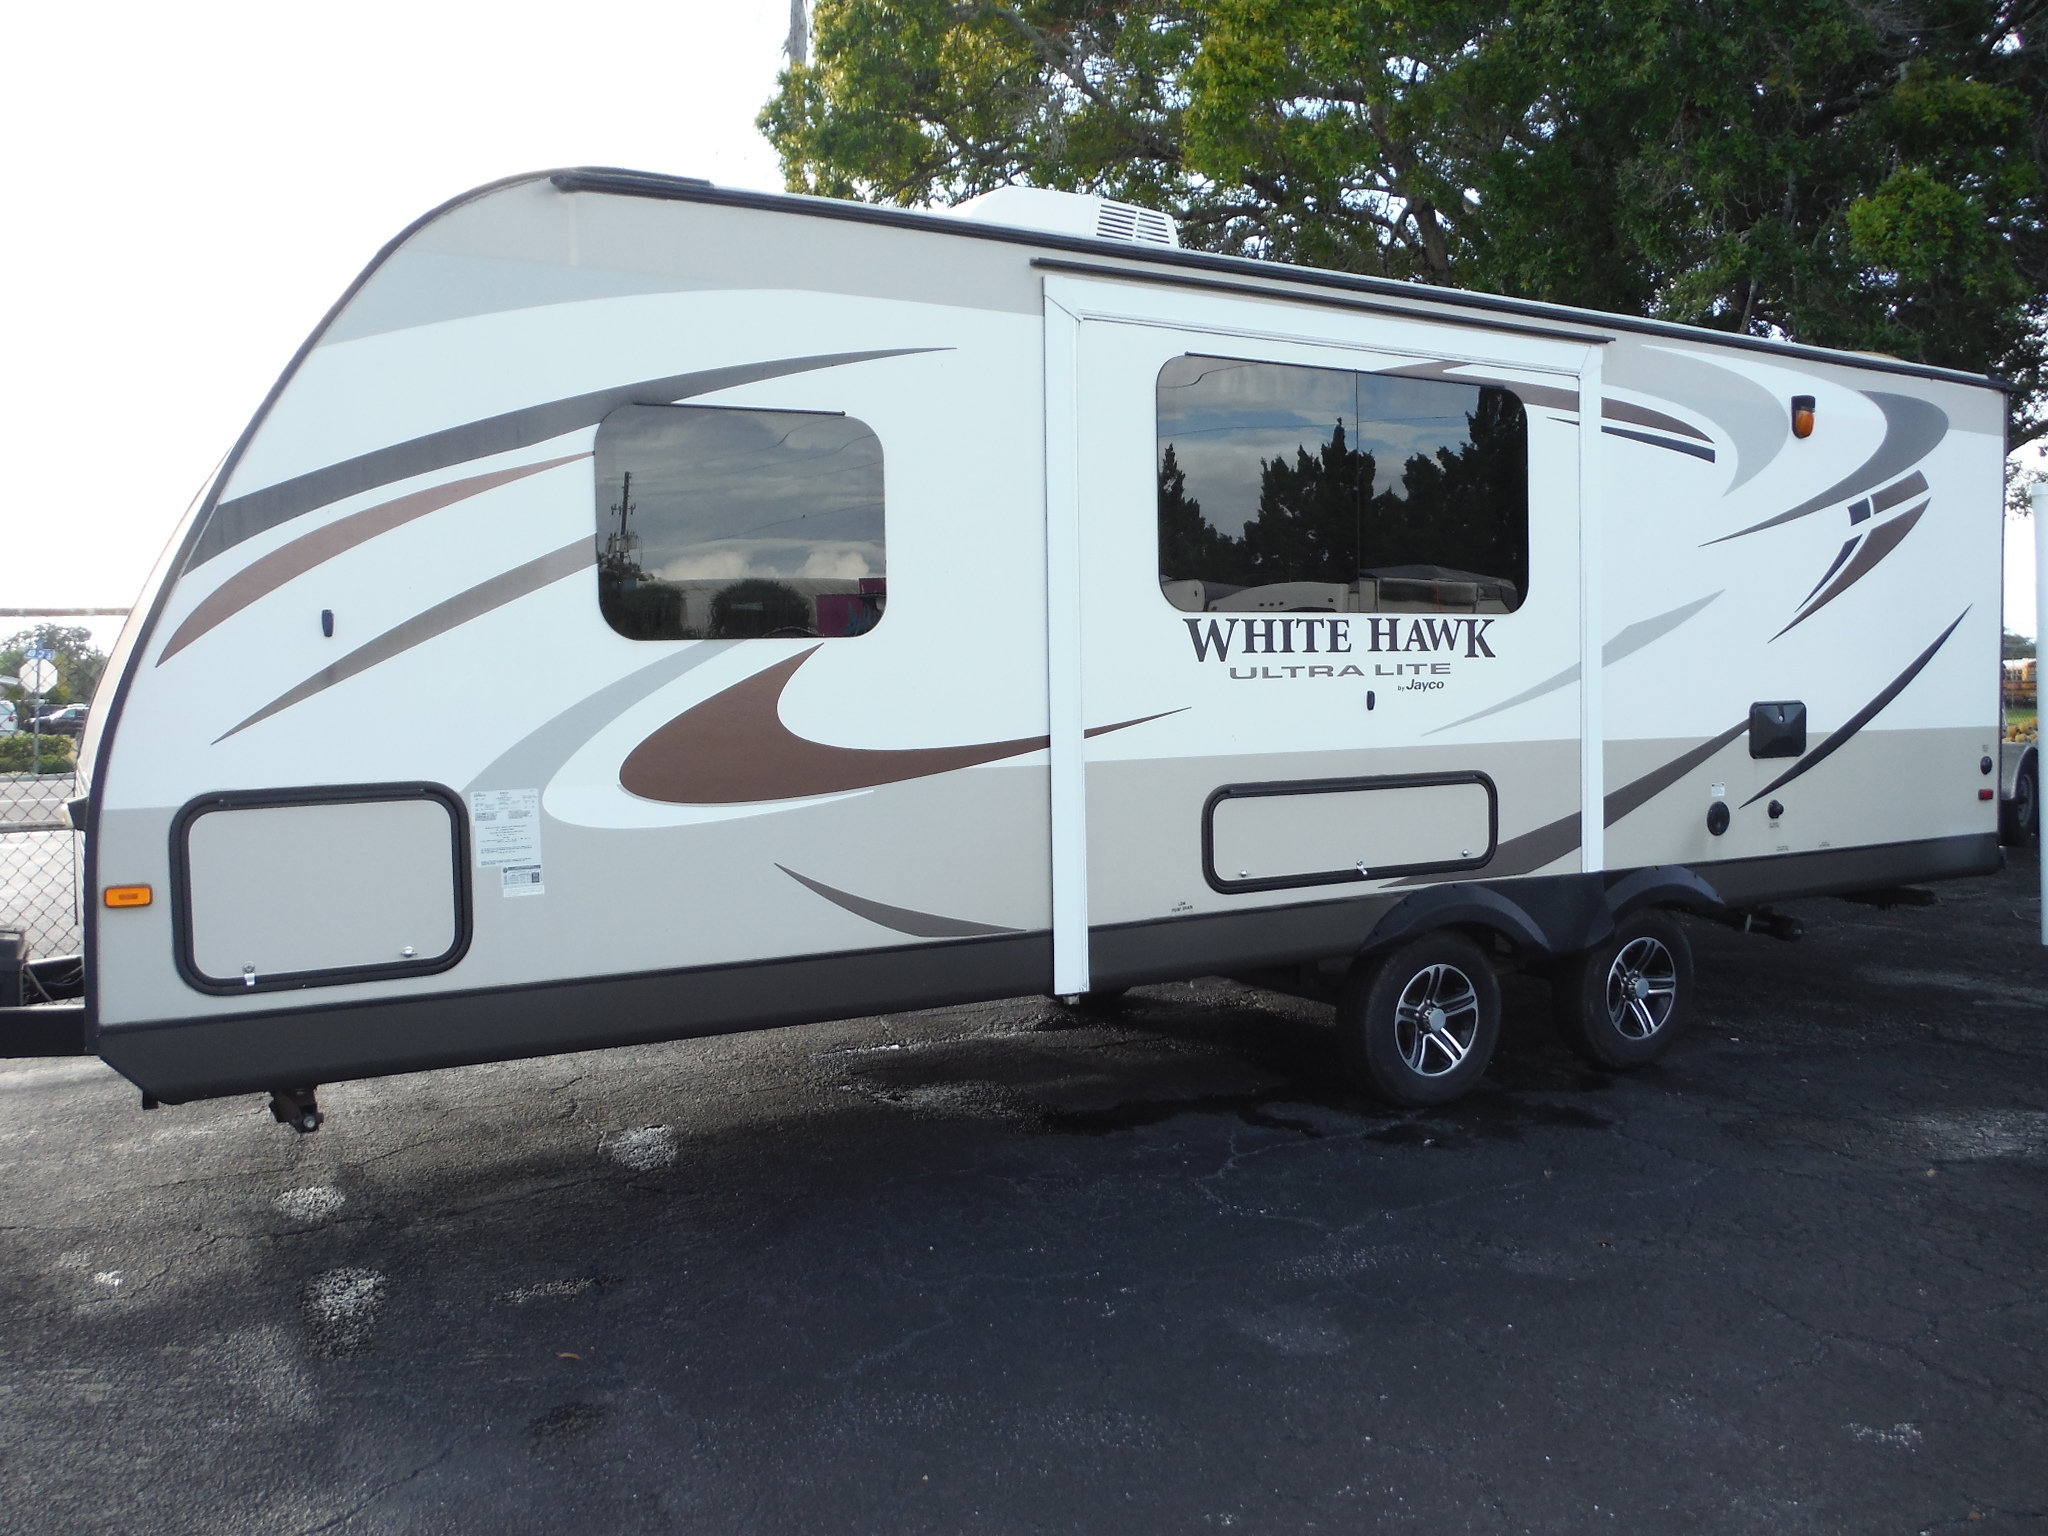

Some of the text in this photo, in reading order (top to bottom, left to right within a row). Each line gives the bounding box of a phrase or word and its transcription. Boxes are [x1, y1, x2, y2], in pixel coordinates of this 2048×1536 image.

[1182, 617, 1496, 663] WHITE HAWK
[1229, 663, 1451, 680] ULTRA LITE
[1397, 679, 1444, 692] by Jayco
